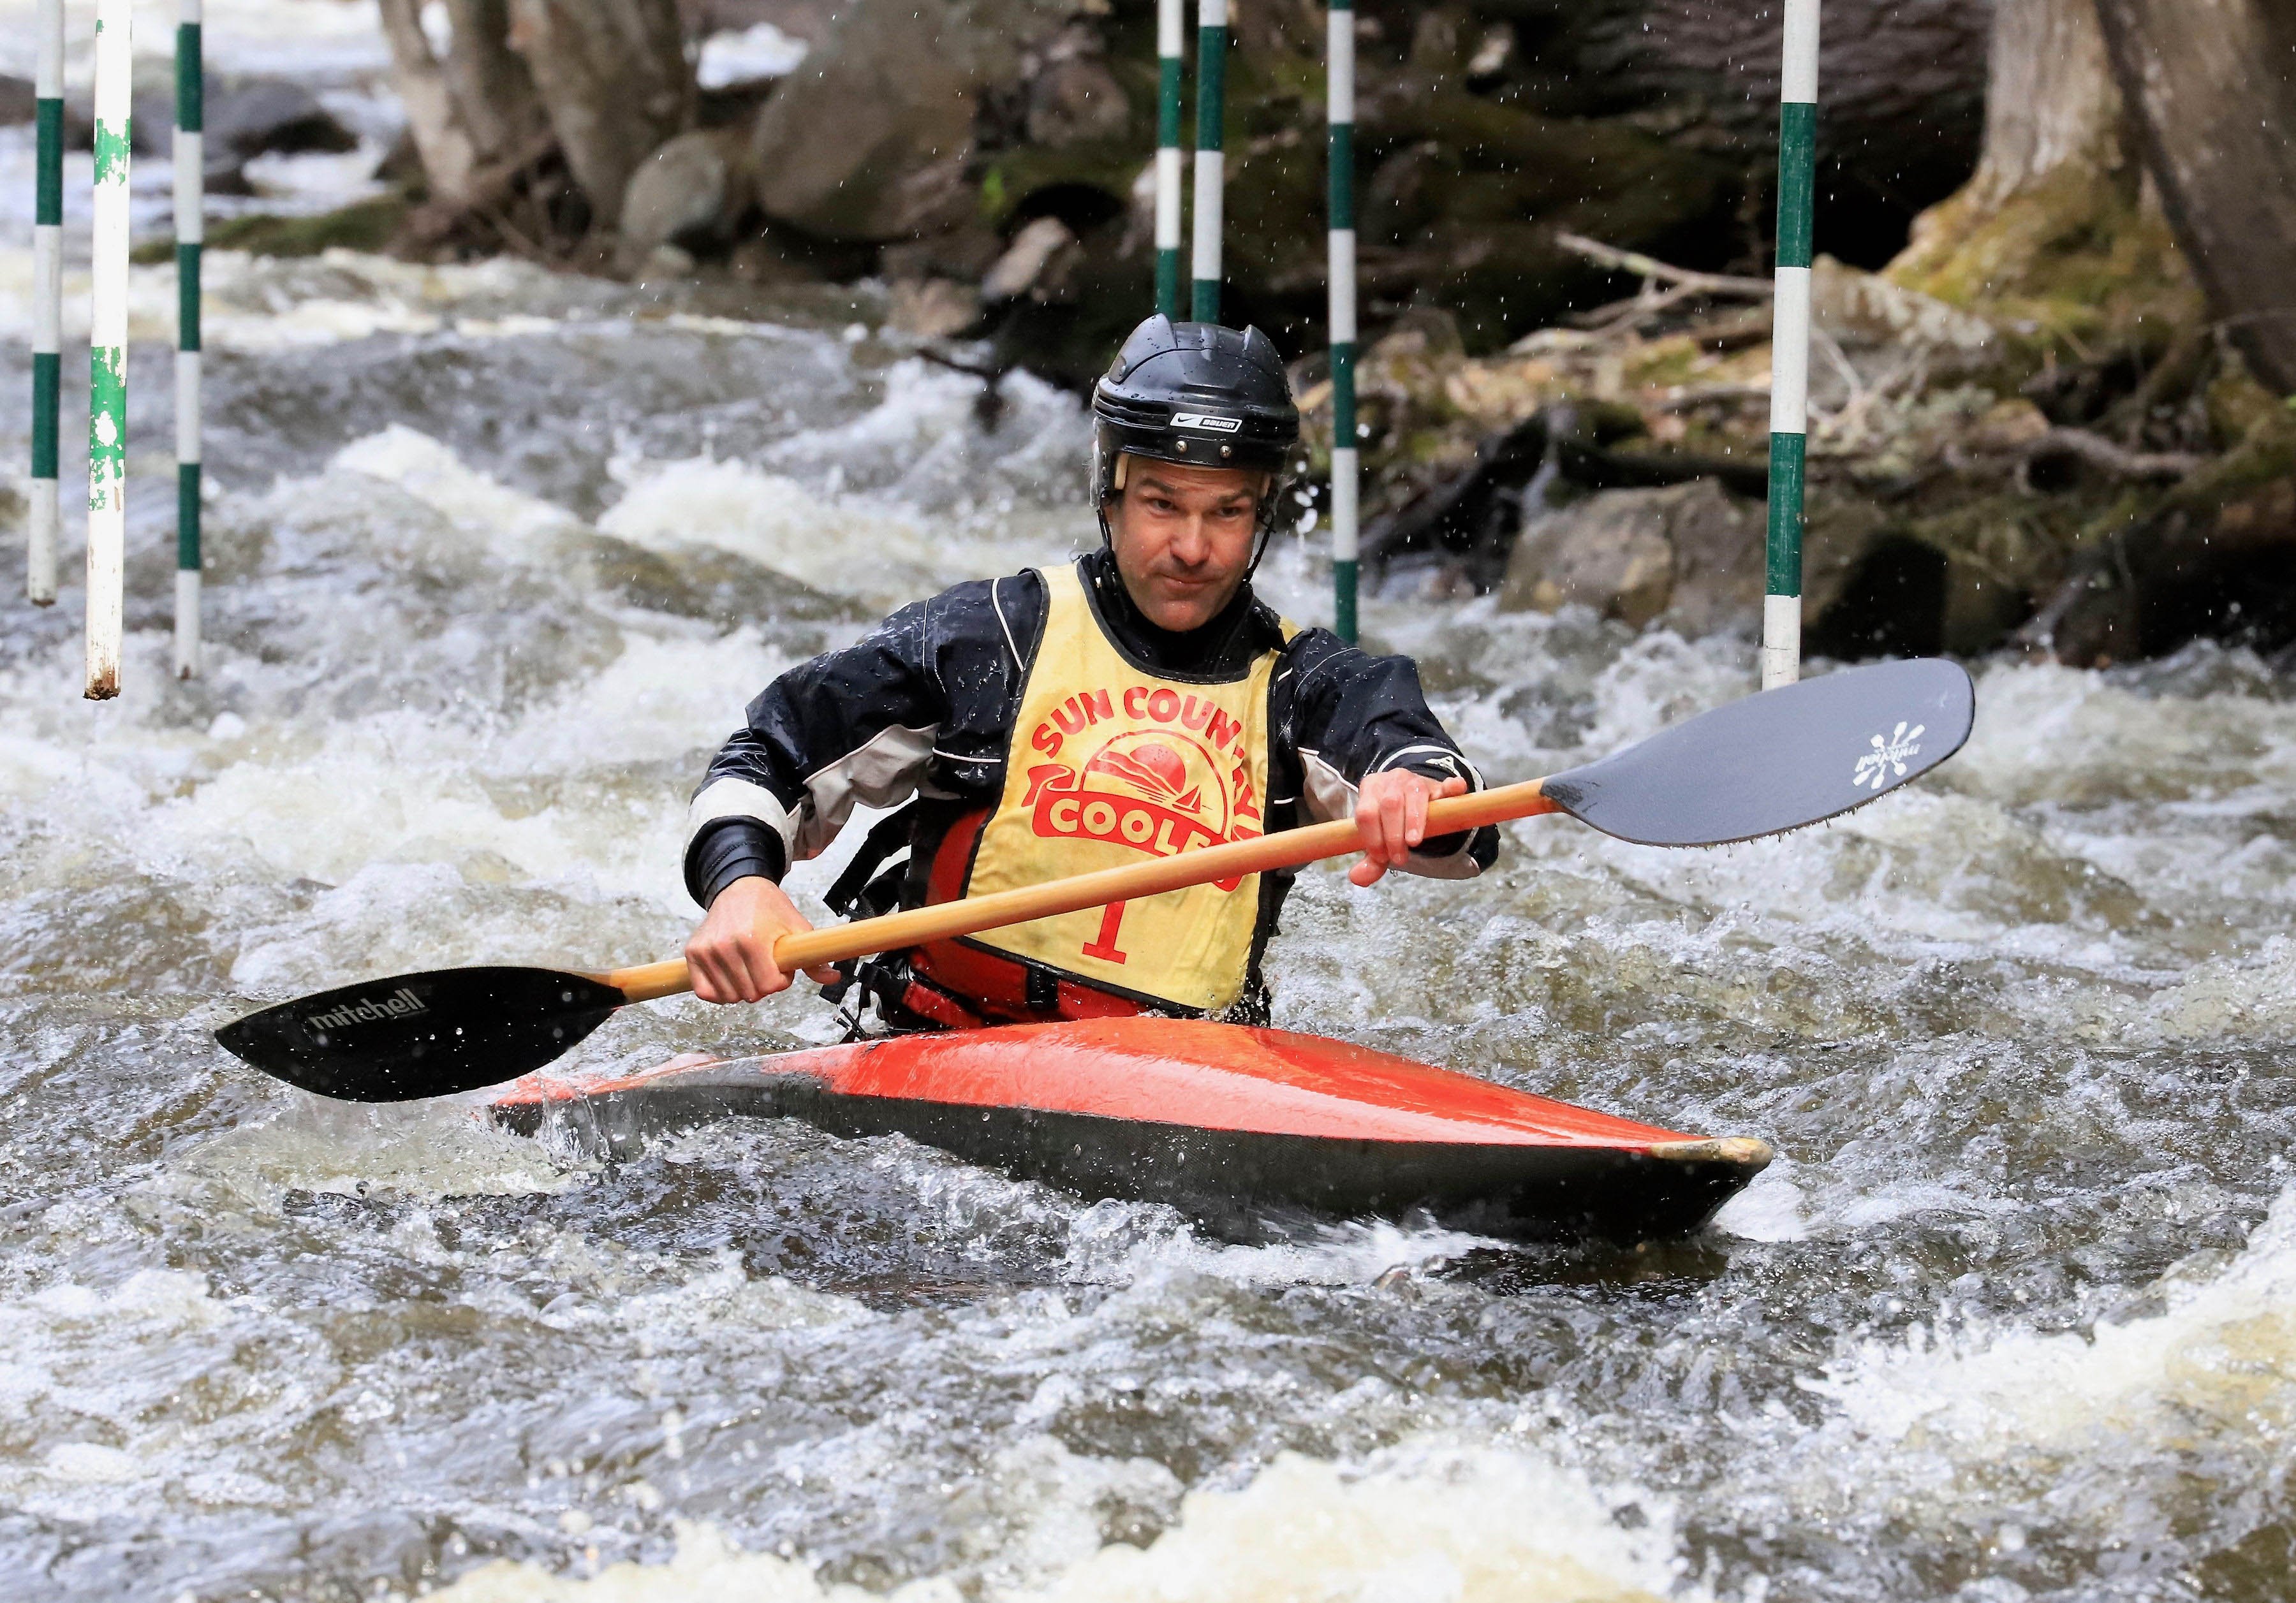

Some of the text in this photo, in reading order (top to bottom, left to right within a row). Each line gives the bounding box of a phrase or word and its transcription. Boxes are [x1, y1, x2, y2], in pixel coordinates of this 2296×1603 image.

[1202, 418, 1235, 429] BAUER
[1031, 686, 1260, 821] SUN COUNY
[1049, 798, 1216, 858] COOLE
[307, 988, 426, 1030] mitchell
